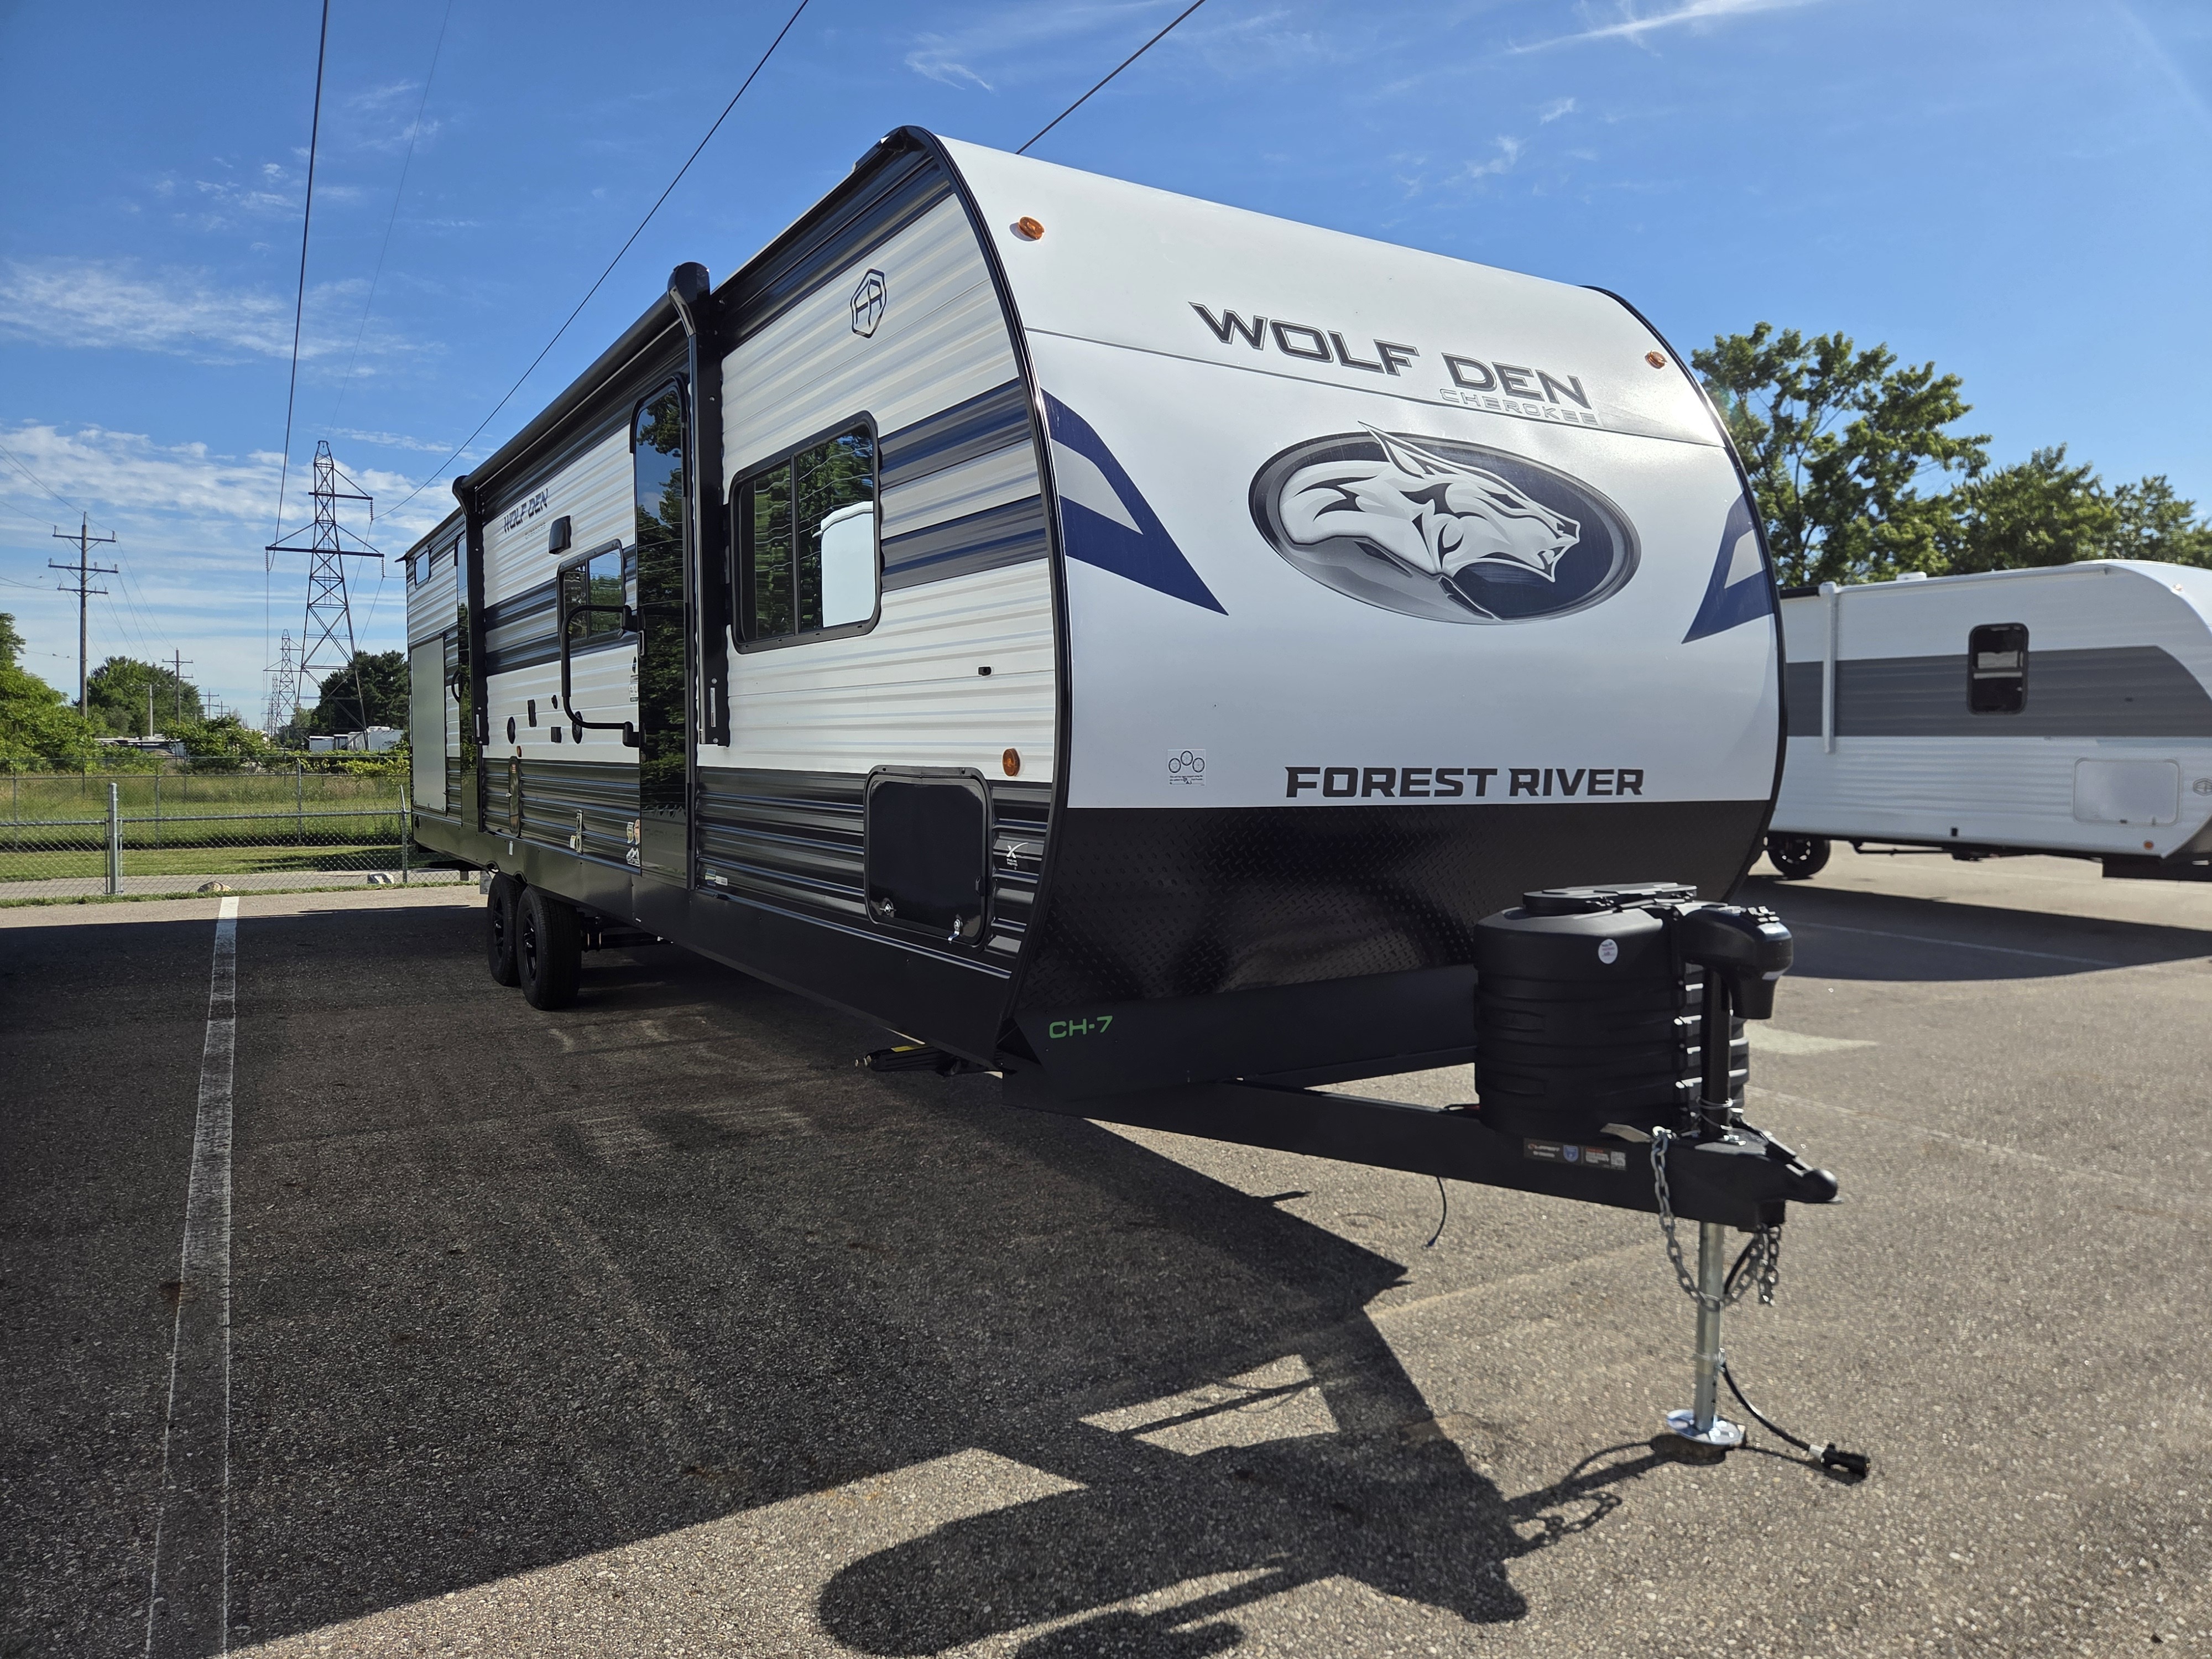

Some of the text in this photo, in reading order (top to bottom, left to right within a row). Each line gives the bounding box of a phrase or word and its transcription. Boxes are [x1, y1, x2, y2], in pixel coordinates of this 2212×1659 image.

[1187, 301, 1592, 410] WOLF DEN
[1439, 388, 1599, 425] CHEROKEE
[504, 488, 549, 534] WOLF DEN
[1285, 766, 1644, 798] FOREST RIVER
[1049, 1015, 1113, 1039] CH-7
